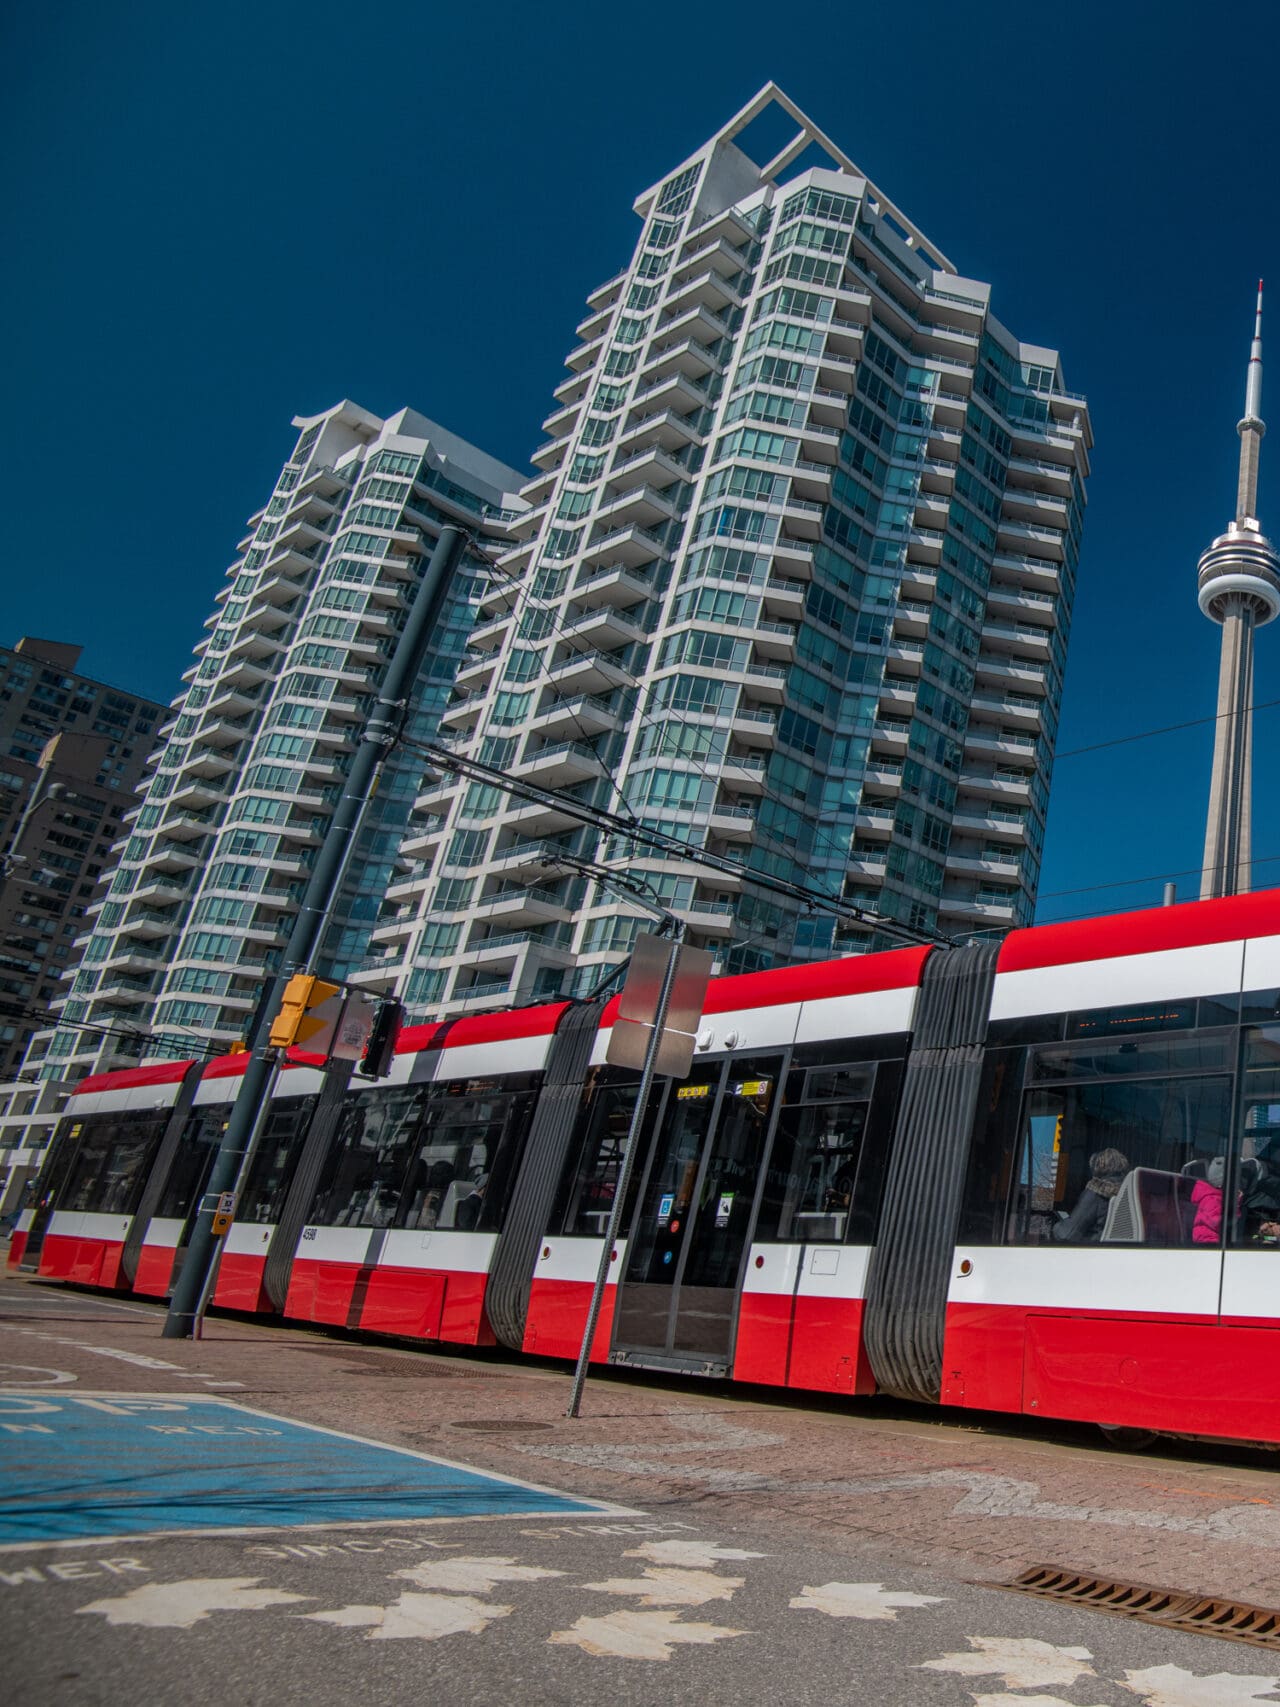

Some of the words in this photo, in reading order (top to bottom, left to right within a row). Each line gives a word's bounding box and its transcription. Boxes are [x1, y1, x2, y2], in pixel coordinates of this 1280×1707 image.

[145, 1424, 284, 1436] RED
[0, 1557, 152, 1586] WER
[243, 1537, 466, 1560] SIMCOE
[519, 1521, 701, 1540] STREET
